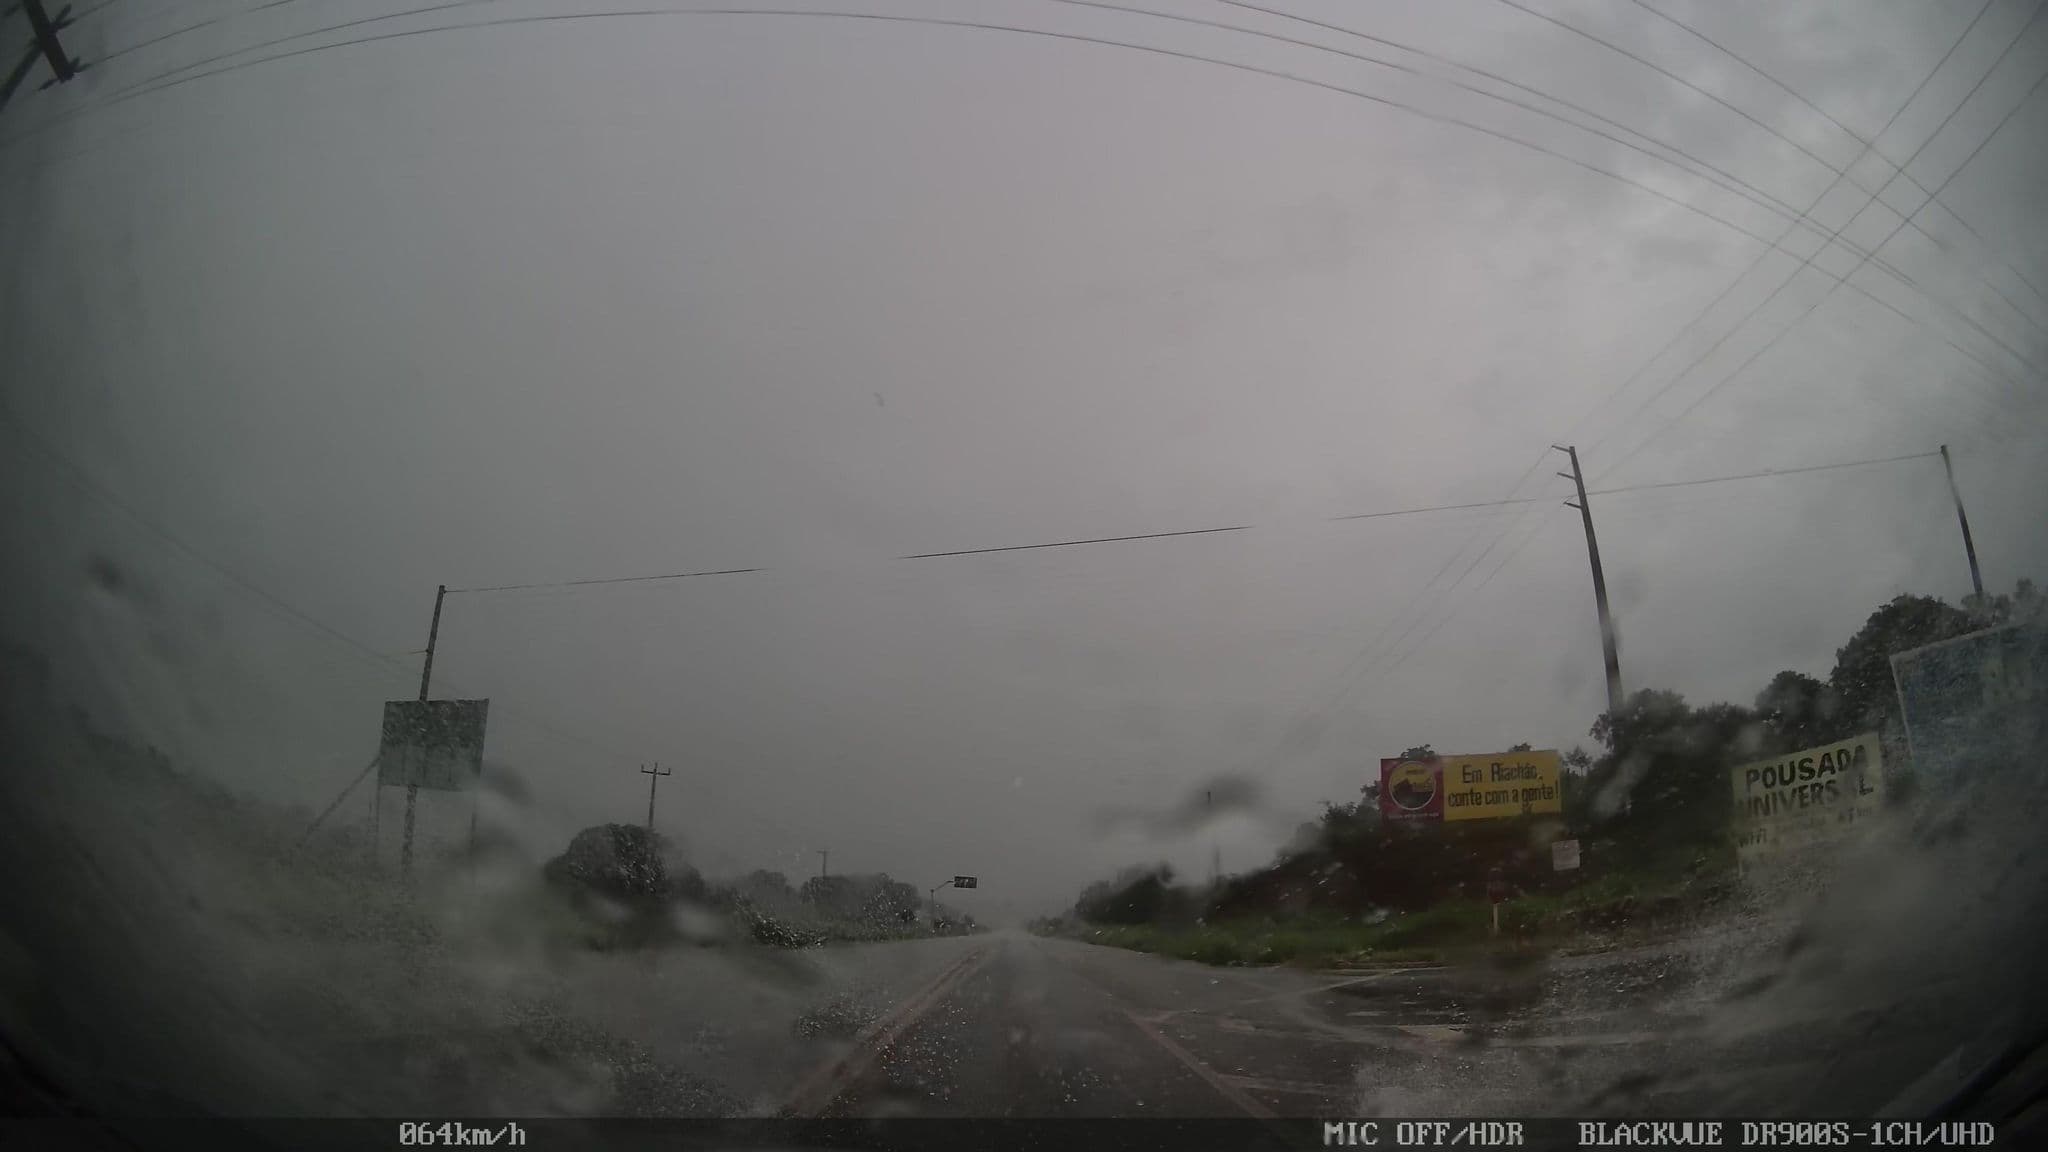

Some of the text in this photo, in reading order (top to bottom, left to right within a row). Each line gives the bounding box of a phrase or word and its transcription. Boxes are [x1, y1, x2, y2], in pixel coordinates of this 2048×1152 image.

[1462, 764, 1482, 783] Em
[1746, 745, 1867, 792] POUSADA
[1448, 788, 1482, 807] conte
[1485, 789, 1508, 805] com
[1511, 788, 1519, 803] a
[1738, 775, 1873, 817] NIVERSL
